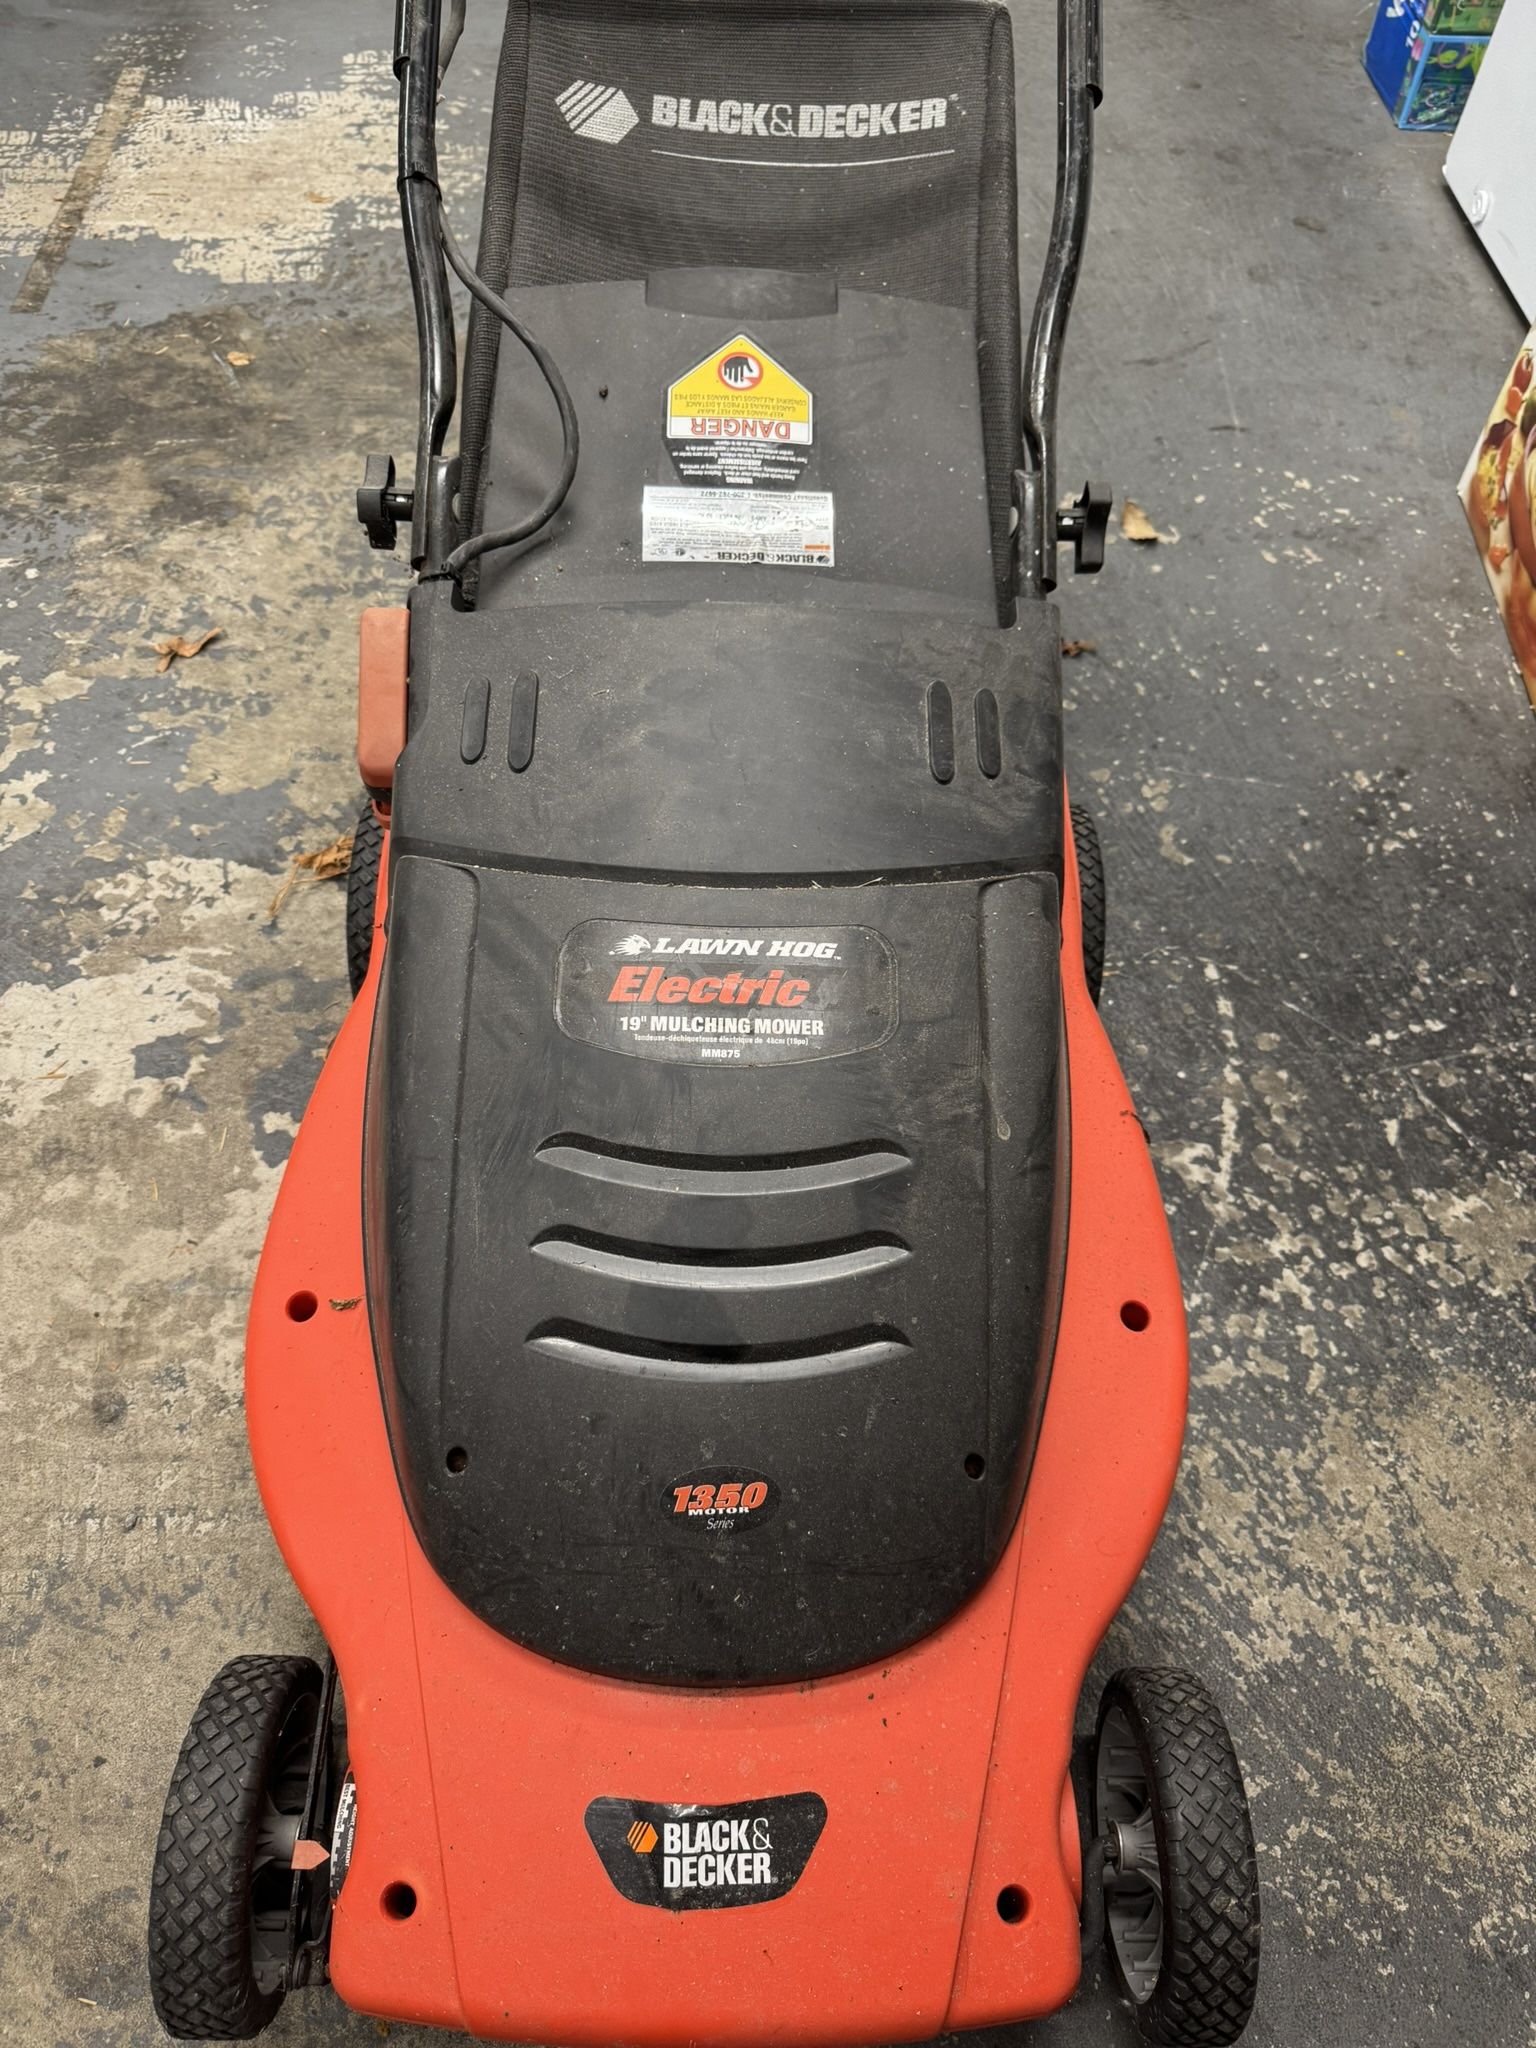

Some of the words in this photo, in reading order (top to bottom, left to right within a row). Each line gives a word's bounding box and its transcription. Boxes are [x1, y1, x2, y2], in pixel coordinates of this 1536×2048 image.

[691, 418, 791, 440] DANGER
[652, 938, 764, 956] LAWN
[766, 940, 838, 959] HOG
[608, 966, 810, 1008] Electric
[620, 1016, 647, 1031] 19"
[650, 1016, 750, 1034] MULCHING
[754, 1018, 824, 1036] MOWER
[702, 1048, 740, 1058] MM875
[674, 1481, 768, 1513] 1350
[688, 1506, 750, 1516] MOTOR
[706, 1517, 734, 1530] Series
[664, 1818, 773, 1854] BLACK&
[664, 1852, 771, 1888] DECKER
